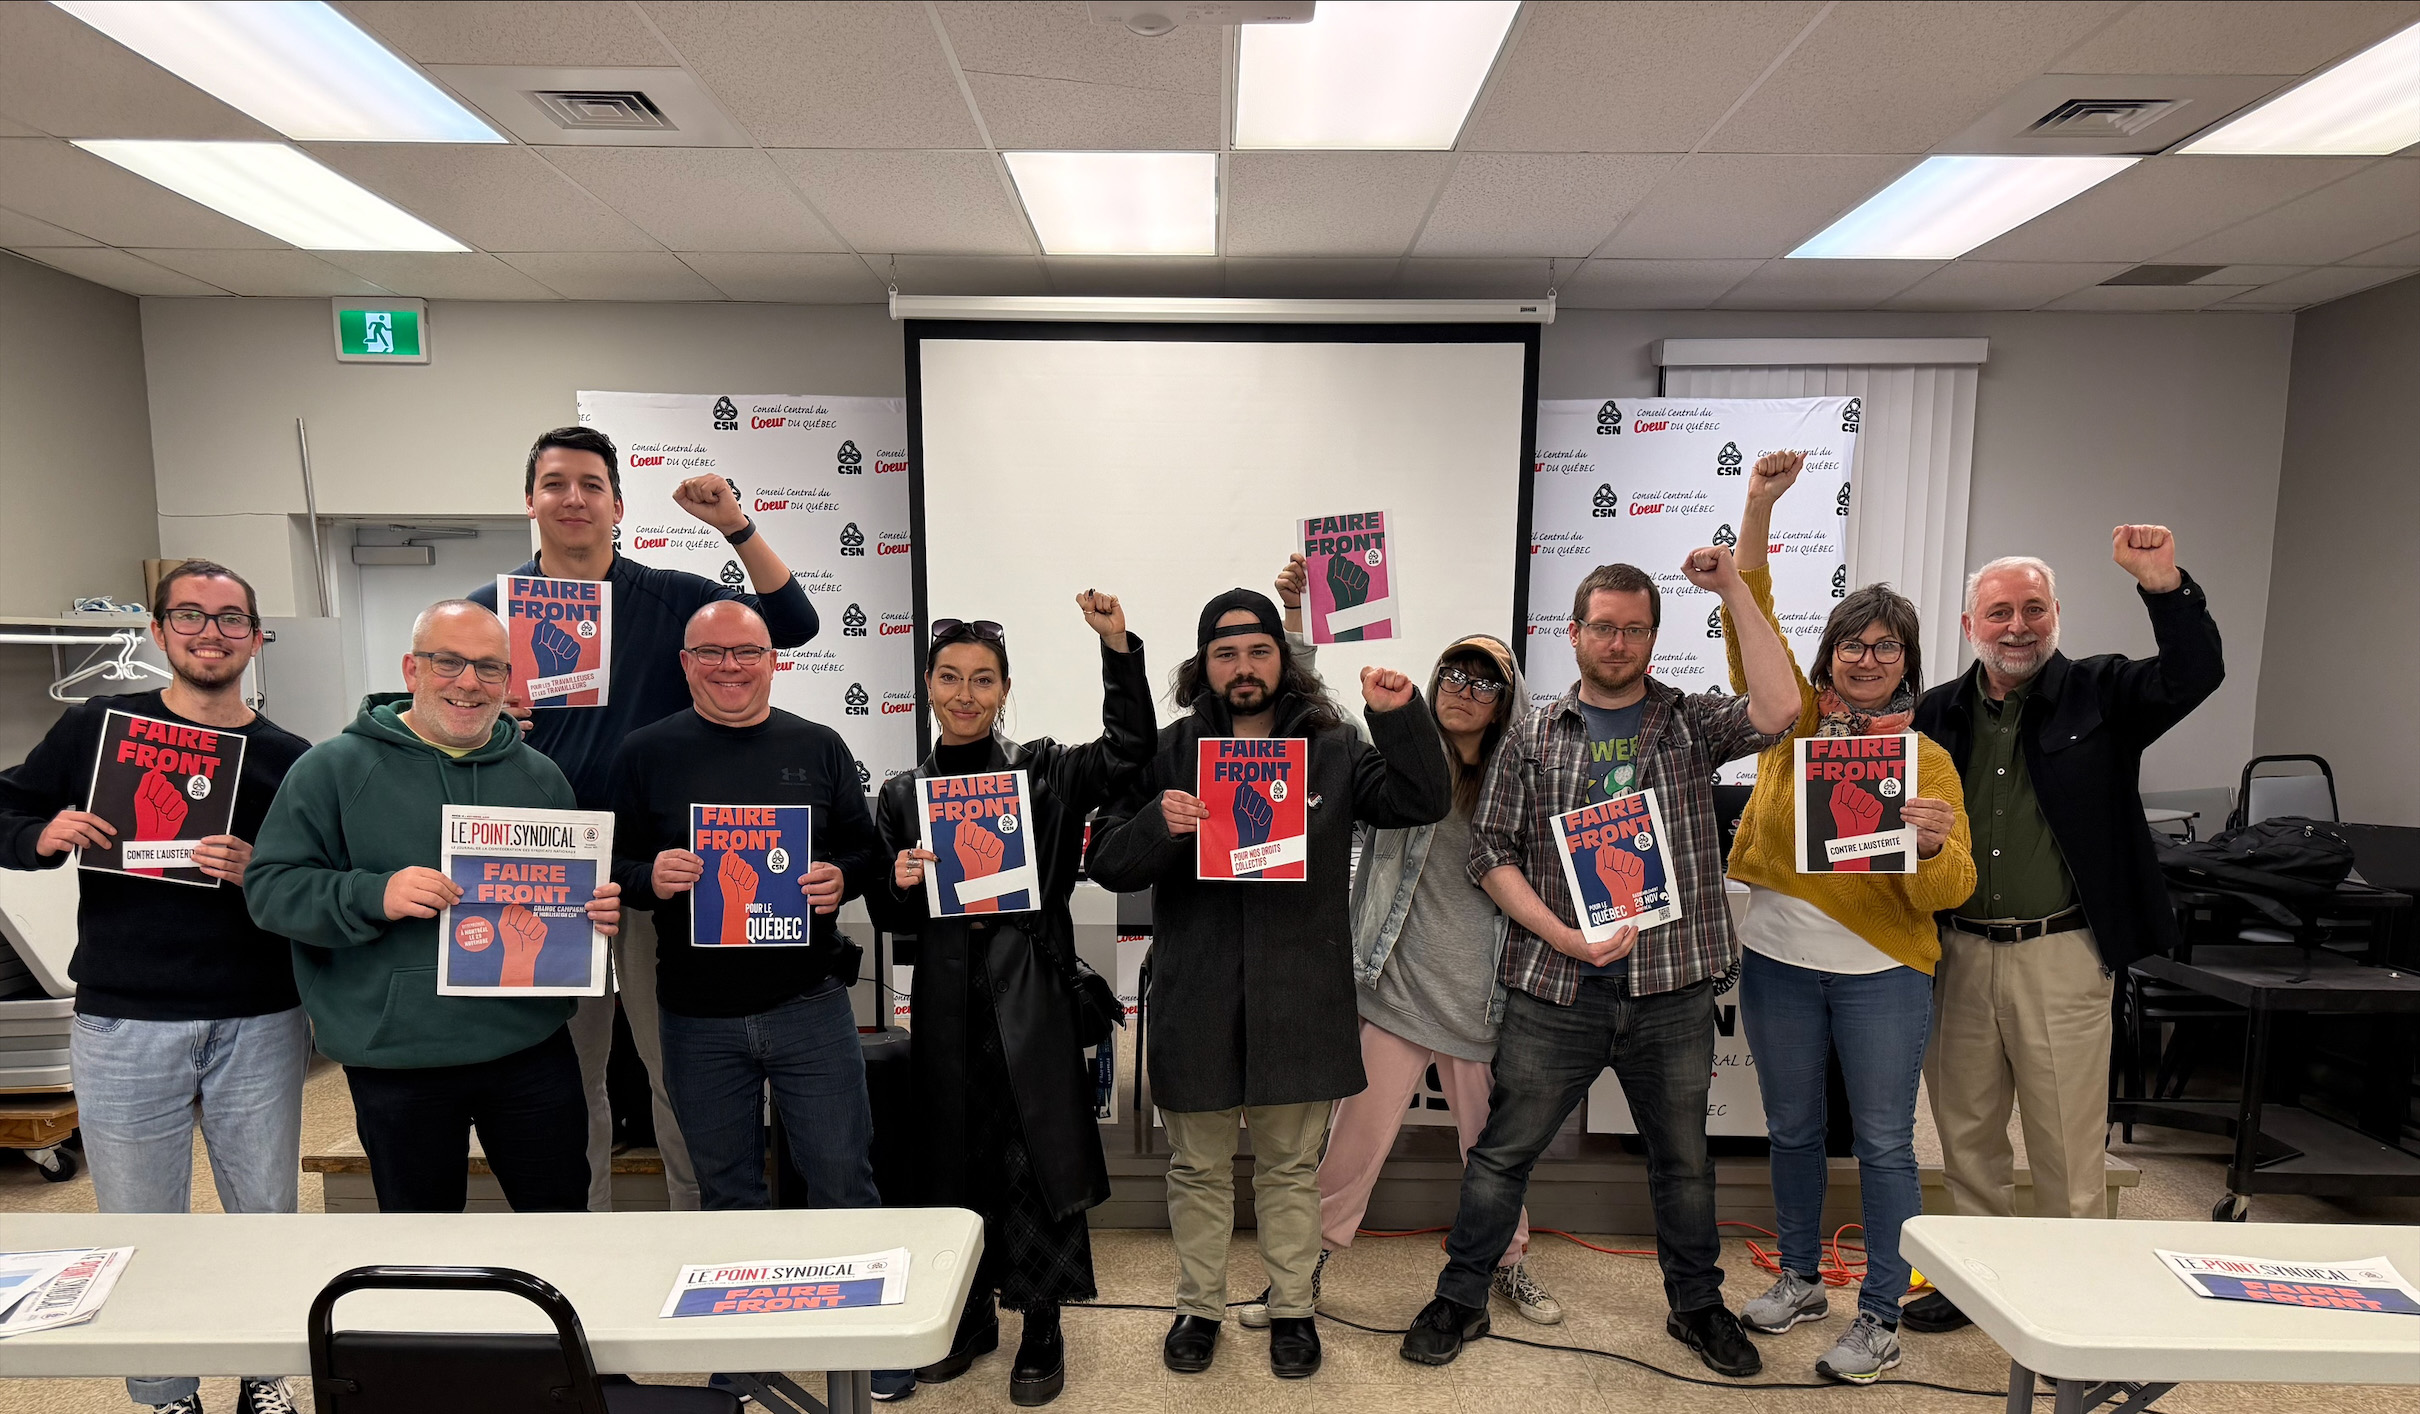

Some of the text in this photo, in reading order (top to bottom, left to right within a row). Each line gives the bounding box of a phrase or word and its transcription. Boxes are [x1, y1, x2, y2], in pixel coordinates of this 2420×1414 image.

[752, 404, 829, 415] Conseil Central du
[1636, 408, 1713, 417] Conseil Central du
[713, 421, 739, 431] CSN
[751, 416, 837, 431] Coeur DU QUÉBEC
[1634, 419, 1721, 434] Coeur DU QUÉBEC
[1596, 425, 1621, 435] CSN
[631, 443, 708, 453] Conseil Central du
[876, 448, 906, 458] Conseil
[1543, 449, 1575, 459] Central
[1574, 449, 1588, 459] du
[1819, 447, 1833, 456] du
[630, 454, 716, 469] Coeur DU QUÉBEC
[874, 459, 909, 474] Coeur
[1805, 461, 1840, 473] QUÉBEC
[837, 465, 862, 475] CSN
[1546, 464, 1559, 472] DU
[1560, 462, 1595, 475] QUÉBEC
[1717, 466, 1741, 476] CSN
[756, 487, 831, 497] Conseil Central du
[1632, 490, 1708, 500] Conseil Central du
[754, 498, 840, 513] Coeur DU QUÉBEC
[1629, 502, 1715, 517] Coeur DU QUÉBEC
[1836, 506, 1849, 516] CS
[1592, 508, 1617, 518] CSN
[1308, 511, 1379, 536] FAIRE
[635, 525, 711, 535] Conseil Central du
[879, 530, 908, 540] Conseil
[1539, 532, 1569, 541] Central
[1570, 531, 1584, 541] du
[1782, 530, 1814, 539] Central
[1814, 529, 1827, 539] du
[634, 536, 669, 550] Coeur
[670, 540, 683, 548] DU
[685, 539, 720, 551] QUÉBEC
[877, 542, 911, 556] Coeur
[1305, 532, 1385, 558] FRONT
[1785, 543, 1834, 555] DU QUÉBEC
[840, 547, 865, 556] CSN
[1542, 546, 1555, 554] DU
[1556, 544, 1591, 556] QUÉBEC
[821, 570, 834, 579] du
[513, 578, 596, 601] FAIRE
[808, 583, 842, 595] QUÉBEC
[1660, 586, 1675, 594] DU
[1831, 588, 1845, 598] CS
[508, 599, 601, 622] FRONT
[880, 612, 911, 620] Conseil
[1777, 612, 1822, 621] Central du
[1535, 613, 1566, 622] Central
[843, 627, 867, 637] CSN
[879, 622, 914, 636] Coeur
[1538, 626, 1551, 635] DU
[1706, 629, 1722, 638] CS
[1780, 624, 1824, 637] DU QUÉBE
[792, 650, 836, 659] Central du
[1653, 652, 1698, 661] Central du
[775, 661, 845, 674] eur DU QUÉBEC
[1656, 666, 1669, 674] DU
[1670, 664, 1705, 676] QUÉBEC
[551, 673, 595, 686] TRAVAILLEUSES
[546, 682, 587, 694] TRAVAILLEURS
[883, 691, 912, 699] Conseil
[1531, 692, 1562, 701] Central
[845, 706, 869, 716] CSN
[881, 701, 915, 715] Coeur
[128, 717, 219, 753] FAIRE
[1219, 740, 1286, 758] FAIRE
[1590, 735, 1638, 762] WER
[1811, 737, 1900, 759] FAIRE
[116, 740, 221, 779] FRONT
[1214, 762, 1291, 782] FRONT
[1736, 771, 1757, 779] Conse
[1806, 760, 1906, 781] FRONT
[931, 774, 1014, 799] FAIRE
[928, 795, 1020, 823] FRONT
[1565, 794, 1644, 832] FAIRE
[702, 807, 776, 826] FAIRE
[696, 829, 782, 850] FRONT
[1565, 814, 1651, 854] FRONT
[1829, 836, 1901, 855] CONTRE L'AUSTÉRITÉ
[126, 850, 155, 860] CONTRE
[1233, 844, 1281, 862] POUR NOS DROITS
[1235, 857, 1267, 871] COLLECTIFS
[483, 862, 566, 883] FAIRE
[478, 884, 571, 904] FRONT
[1633, 896, 1644, 908] 29
[1644, 891, 1658, 904] NOV
[745, 903, 772, 913] POUR LE
[1589, 900, 1608, 911] POUR LE
[1591, 904, 1628, 926] QUÉBEC
[745, 913, 803, 943] QUÉBEC
[724, 1284, 840, 1300] FAIRE
[2240, 1280, 2366, 1299] FAIRE
[712, 1295, 846, 1313] FRONT
[2244, 1289, 2383, 1311] FRONT
